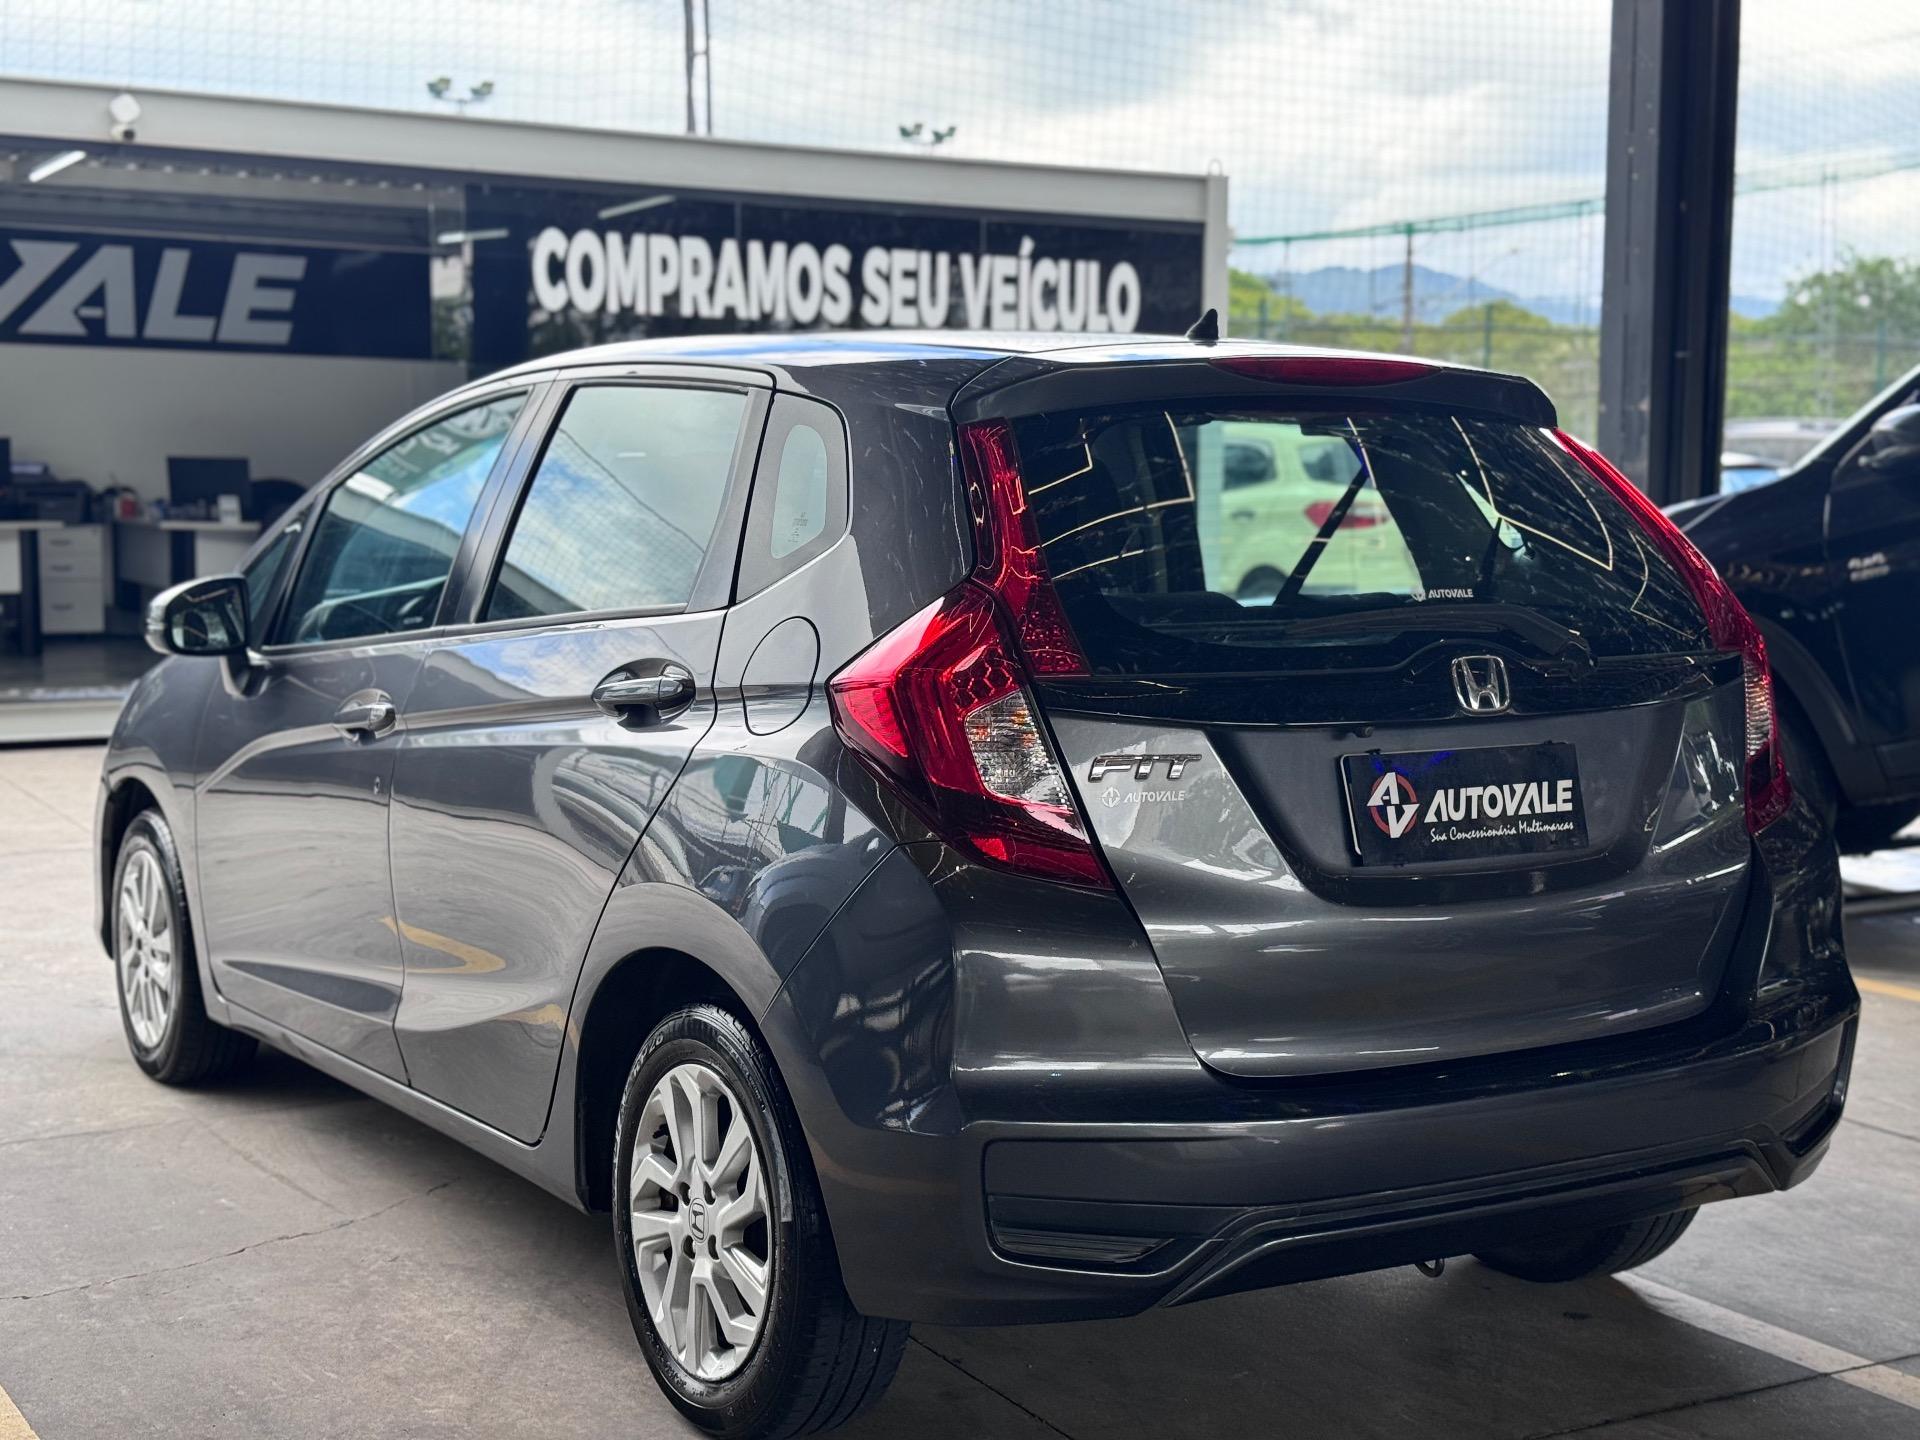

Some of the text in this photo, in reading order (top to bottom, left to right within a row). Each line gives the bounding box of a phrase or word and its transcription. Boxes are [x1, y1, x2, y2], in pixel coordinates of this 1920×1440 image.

[532, 226, 1141, 333] COMPRAMOS SEU VEÍCULO
[1428, 588, 1474, 599] AUTOVALE
[1088, 754, 1202, 783] FIT
[1124, 790, 1186, 803] AUTOVALE
[1423, 779, 1573, 824] AUTOVALE
[1430, 818, 1574, 843] Sua Concessionária Multimarcas
